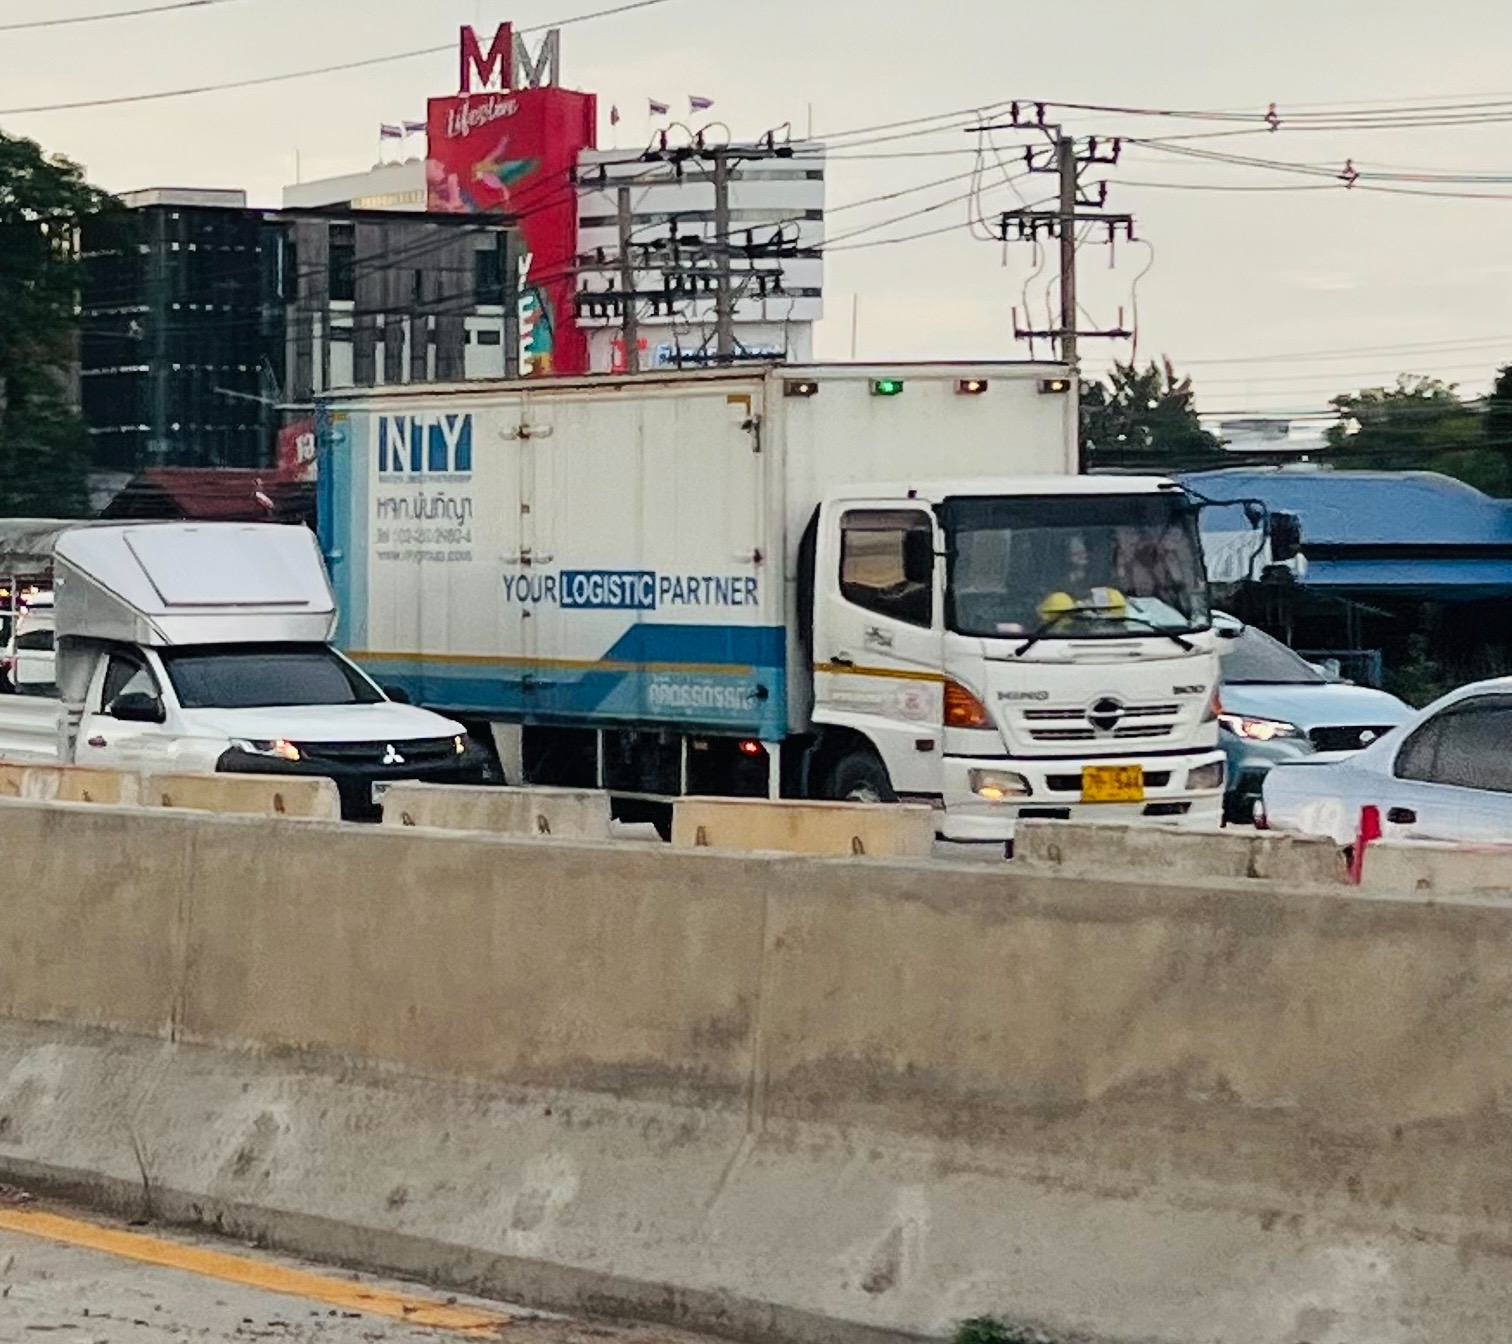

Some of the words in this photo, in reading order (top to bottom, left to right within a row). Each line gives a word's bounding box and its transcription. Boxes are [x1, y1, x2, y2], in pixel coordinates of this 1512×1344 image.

[381, 414, 472, 472] NTY
[503, 574, 557, 603] YOUR
[561, 573, 654, 607] LOGISTIC
[660, 575, 759, 606] PARTNER
